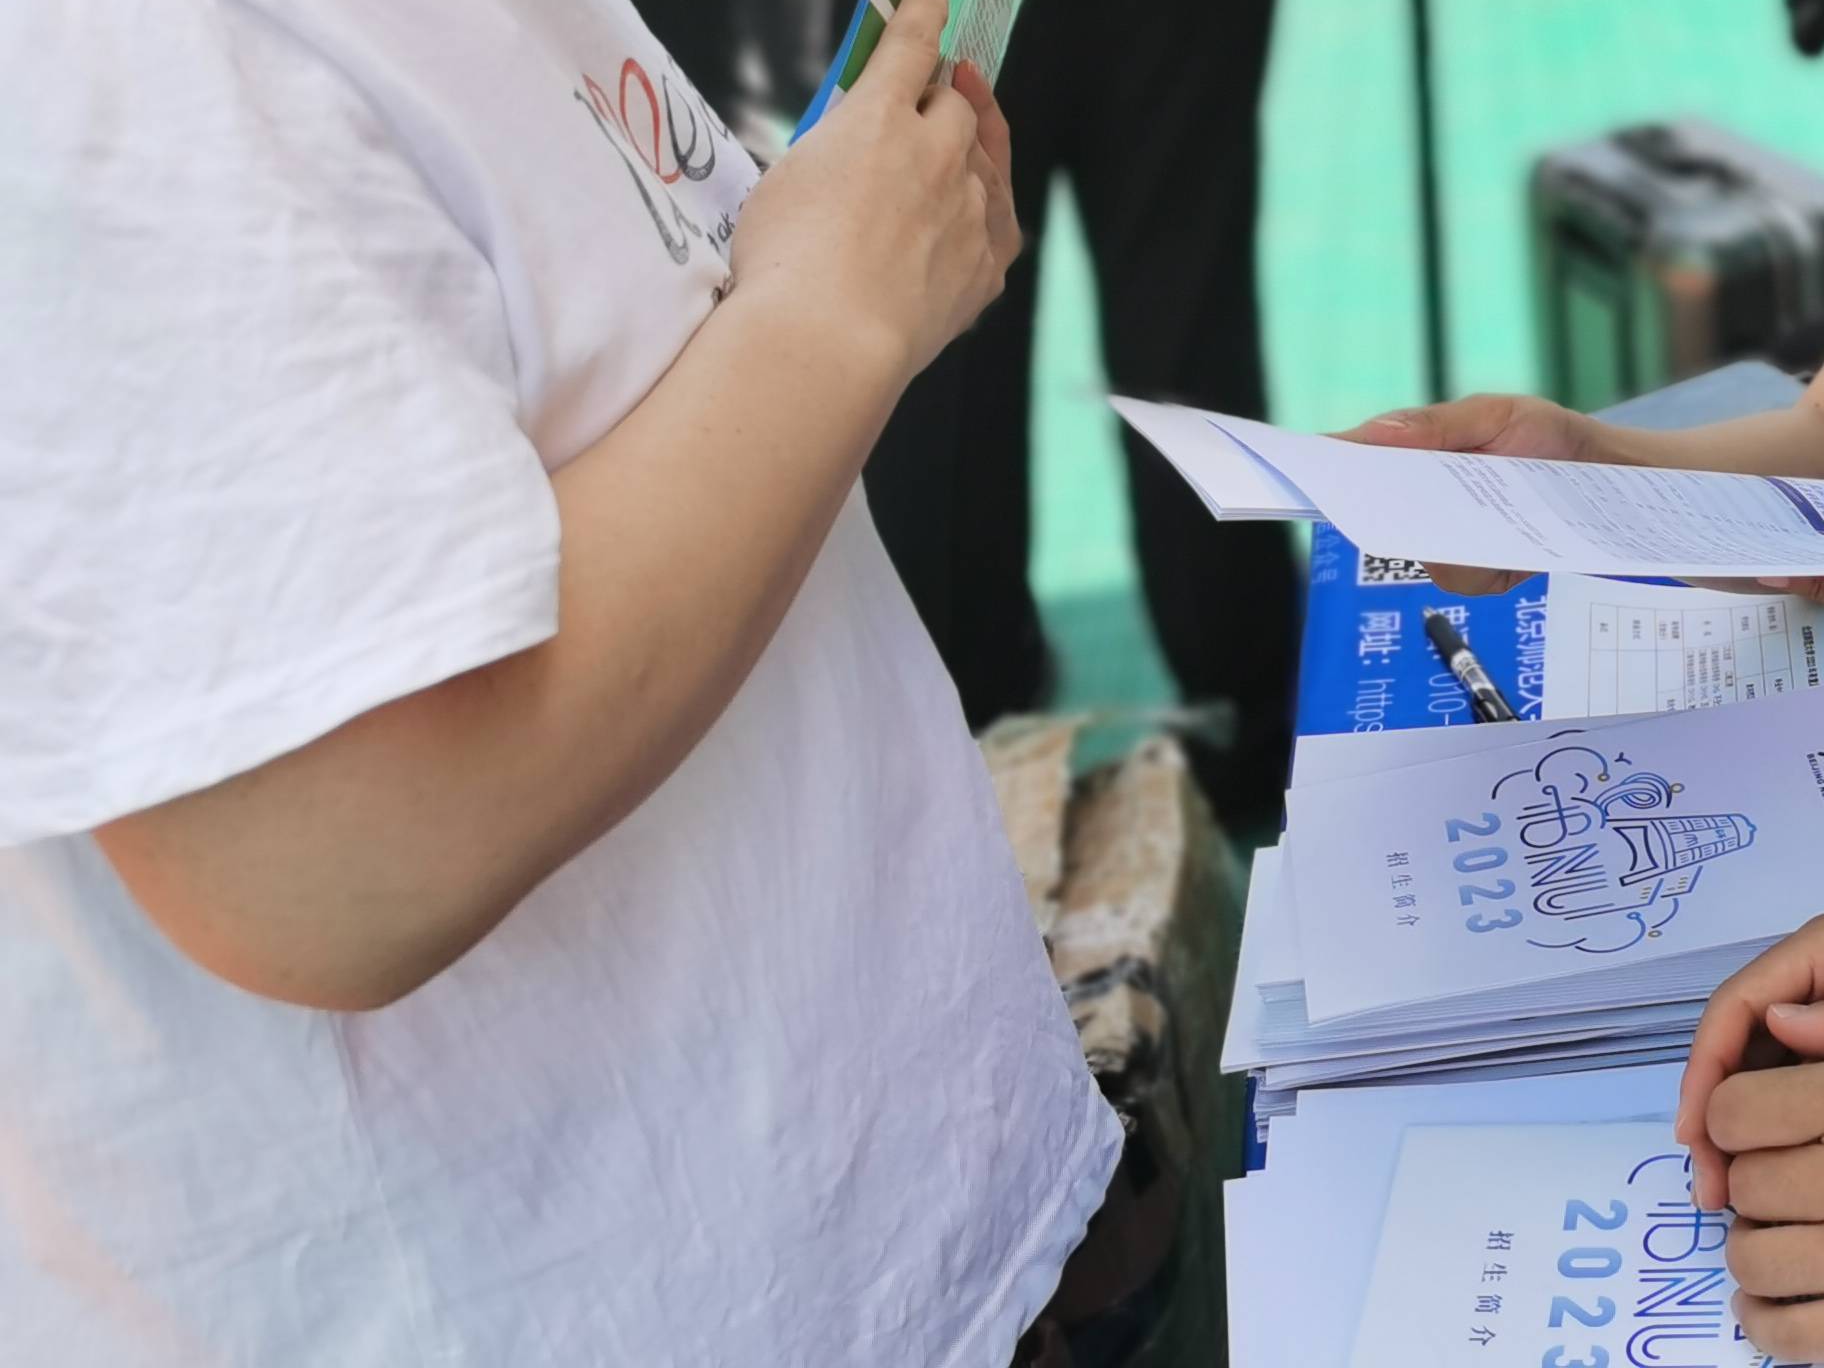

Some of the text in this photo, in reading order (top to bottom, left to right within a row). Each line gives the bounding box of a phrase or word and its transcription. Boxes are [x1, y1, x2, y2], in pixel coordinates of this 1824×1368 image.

[1514, 594, 1549, 723] 北京师范大
[1806, 753, 1824, 785] BEIJING
[1385, 851, 1421, 927] 招生简介
[1444, 812, 1524, 933] 2023
[1469, 1231, 1514, 1346] 招生简介
